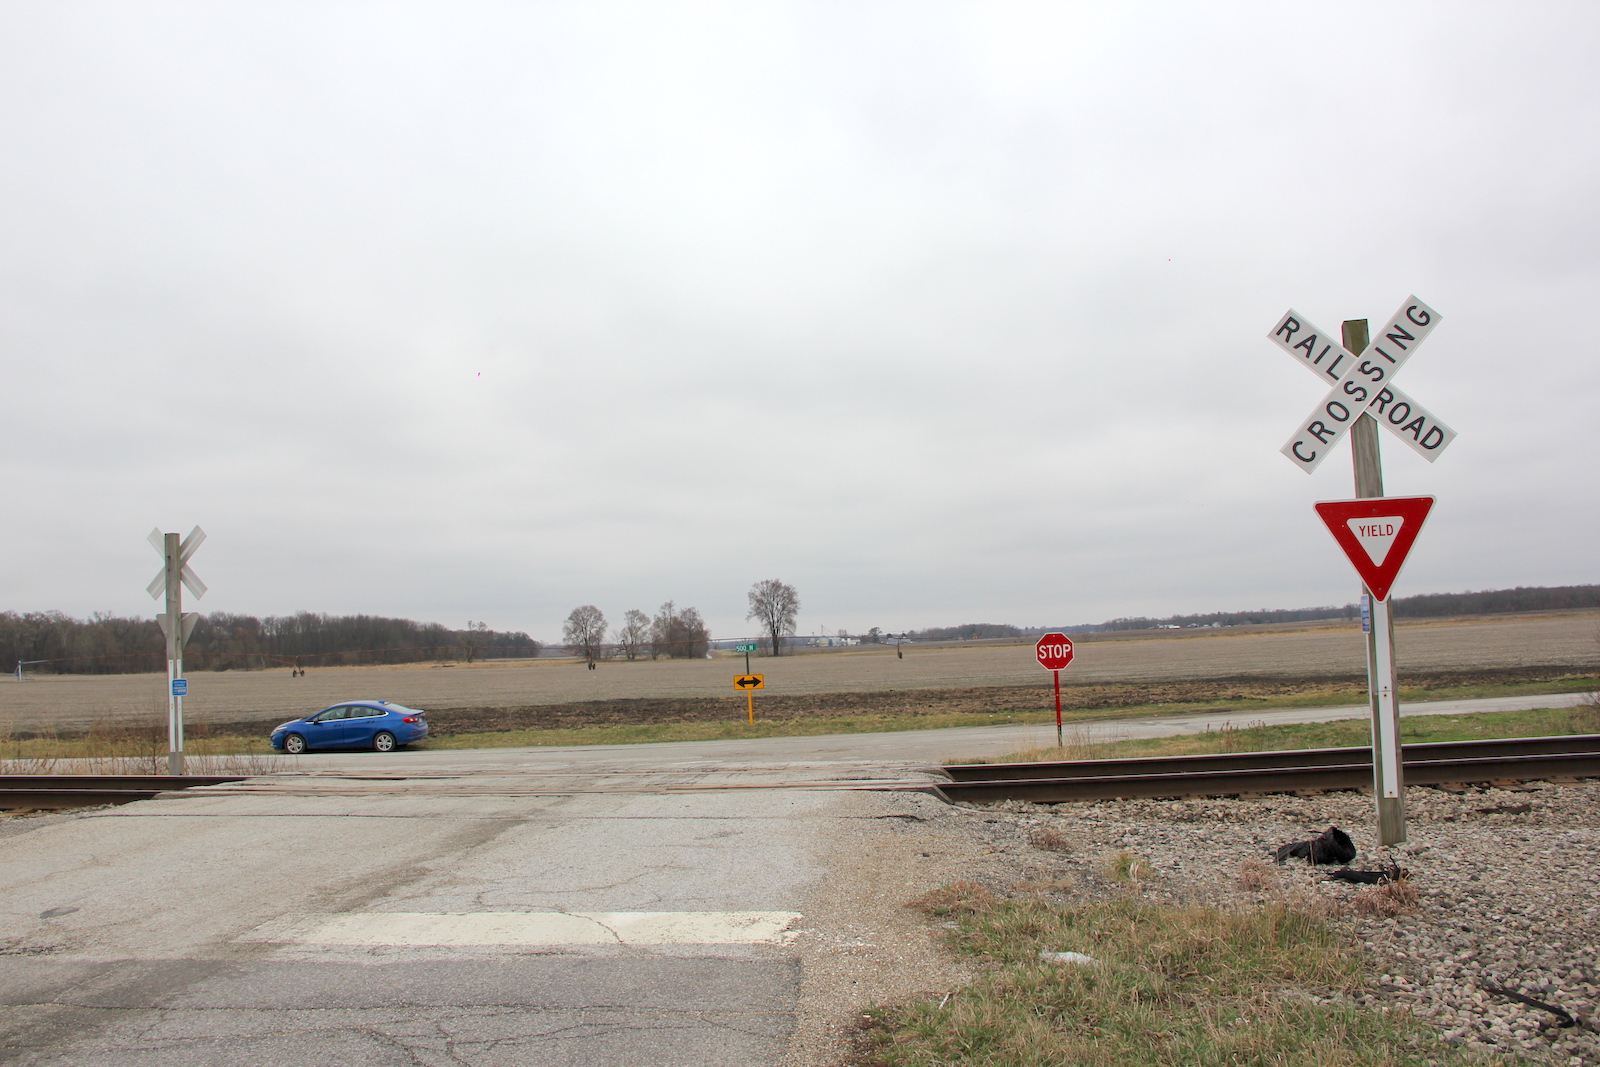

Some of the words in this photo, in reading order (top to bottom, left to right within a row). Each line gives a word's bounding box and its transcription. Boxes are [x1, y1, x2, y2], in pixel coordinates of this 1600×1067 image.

[1275, 316, 1344, 381] RAIL
[1369, 387, 1444, 450] ROAD
[1292, 305, 1431, 463] CROSSING
[1358, 524, 1394, 537] YIELD
[1038, 644, 1071, 659] STOP
